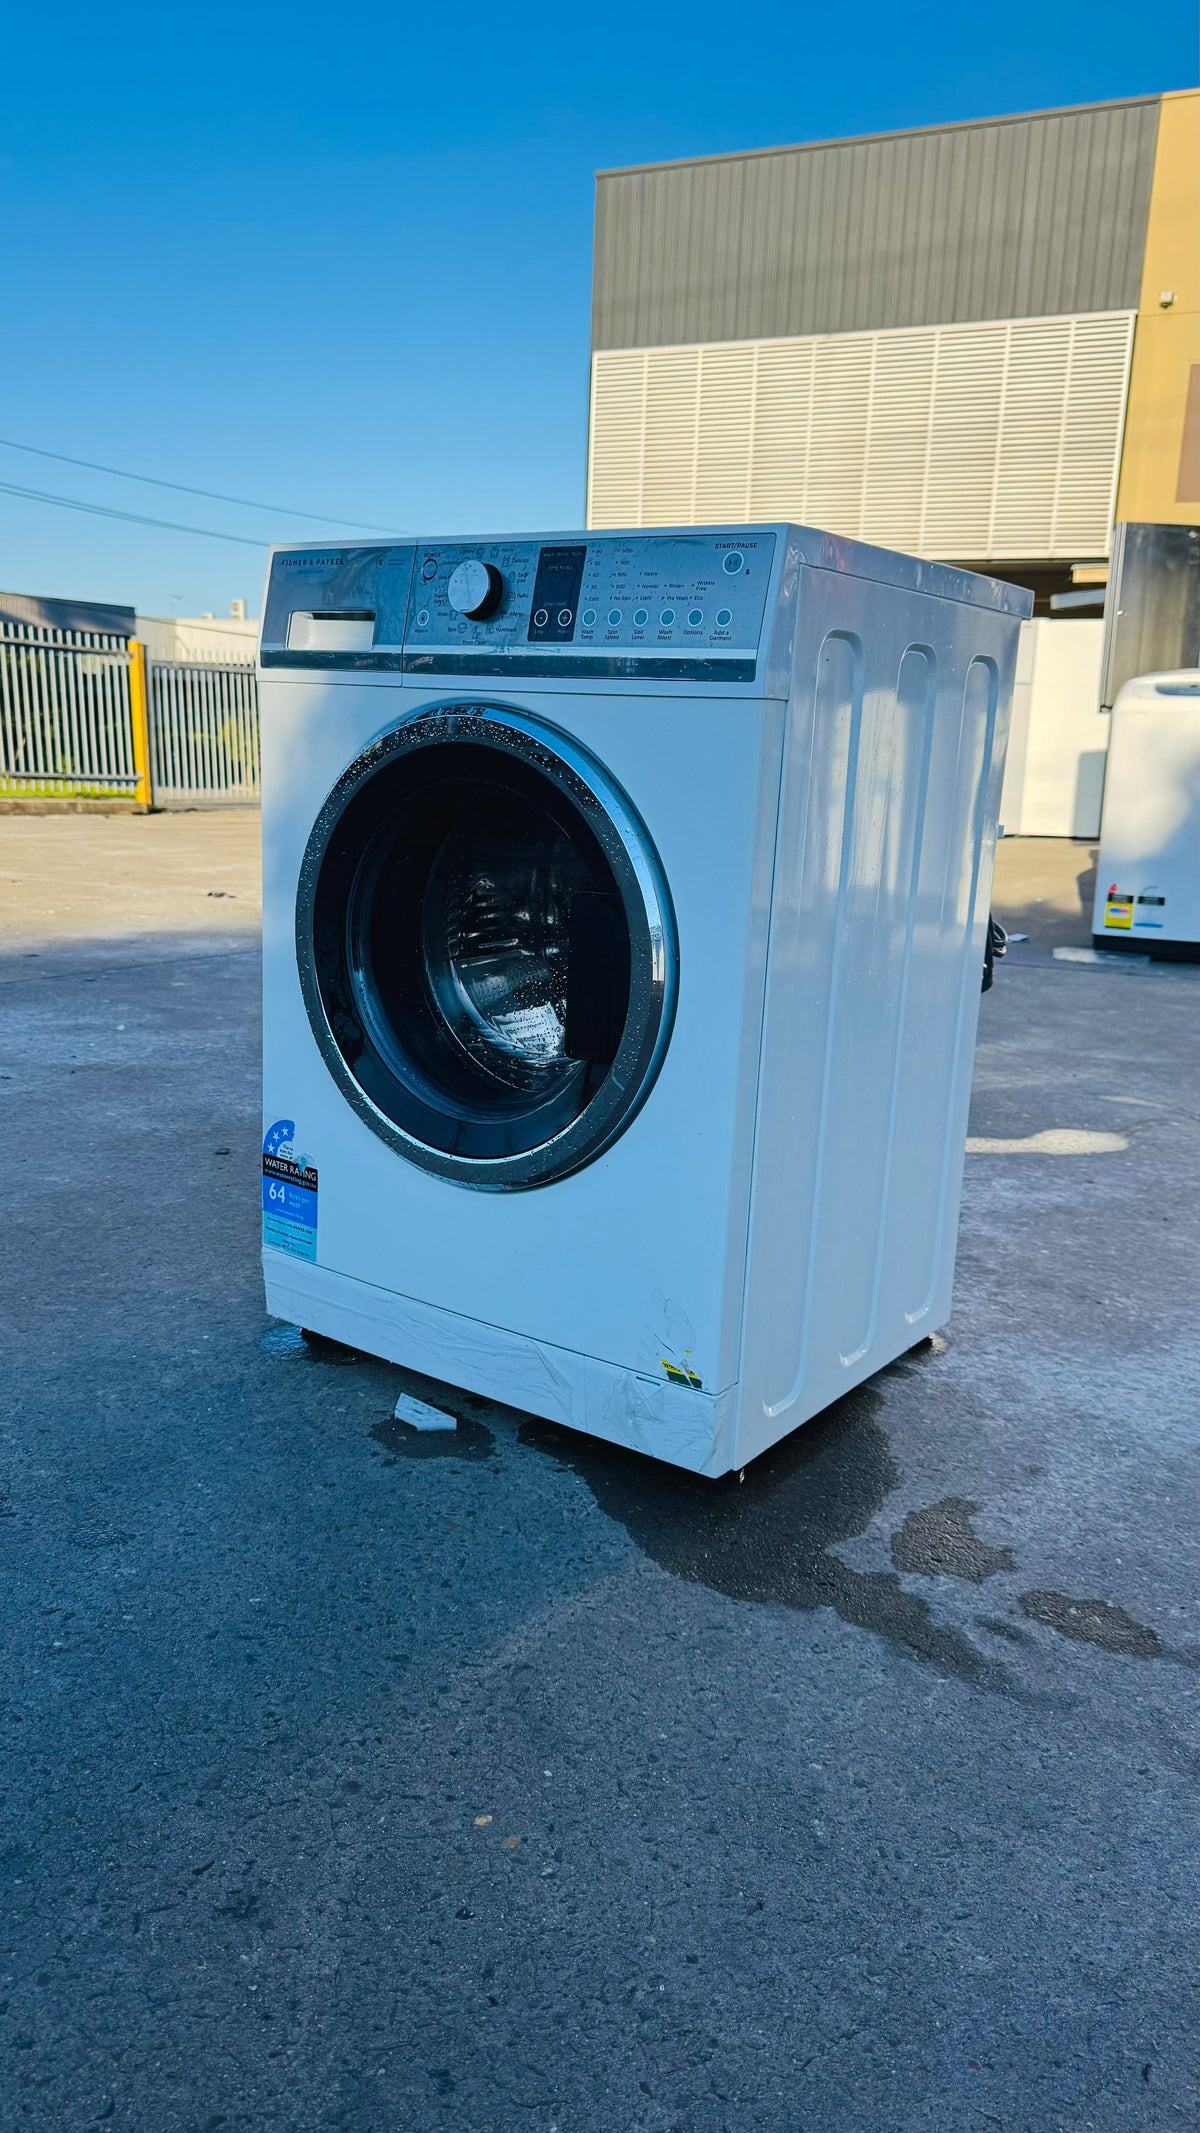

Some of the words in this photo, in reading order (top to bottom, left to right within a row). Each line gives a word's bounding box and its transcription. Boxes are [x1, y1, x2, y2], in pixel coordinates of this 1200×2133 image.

[281, 558, 307, 567] FISHER
[309, 558, 314, 566] &
[316, 557, 344, 566] PAYKEL
[264, 1157, 289, 1173] WATER
[289, 1165, 317, 1182] RATING
[269, 1182, 286, 1204] 64
